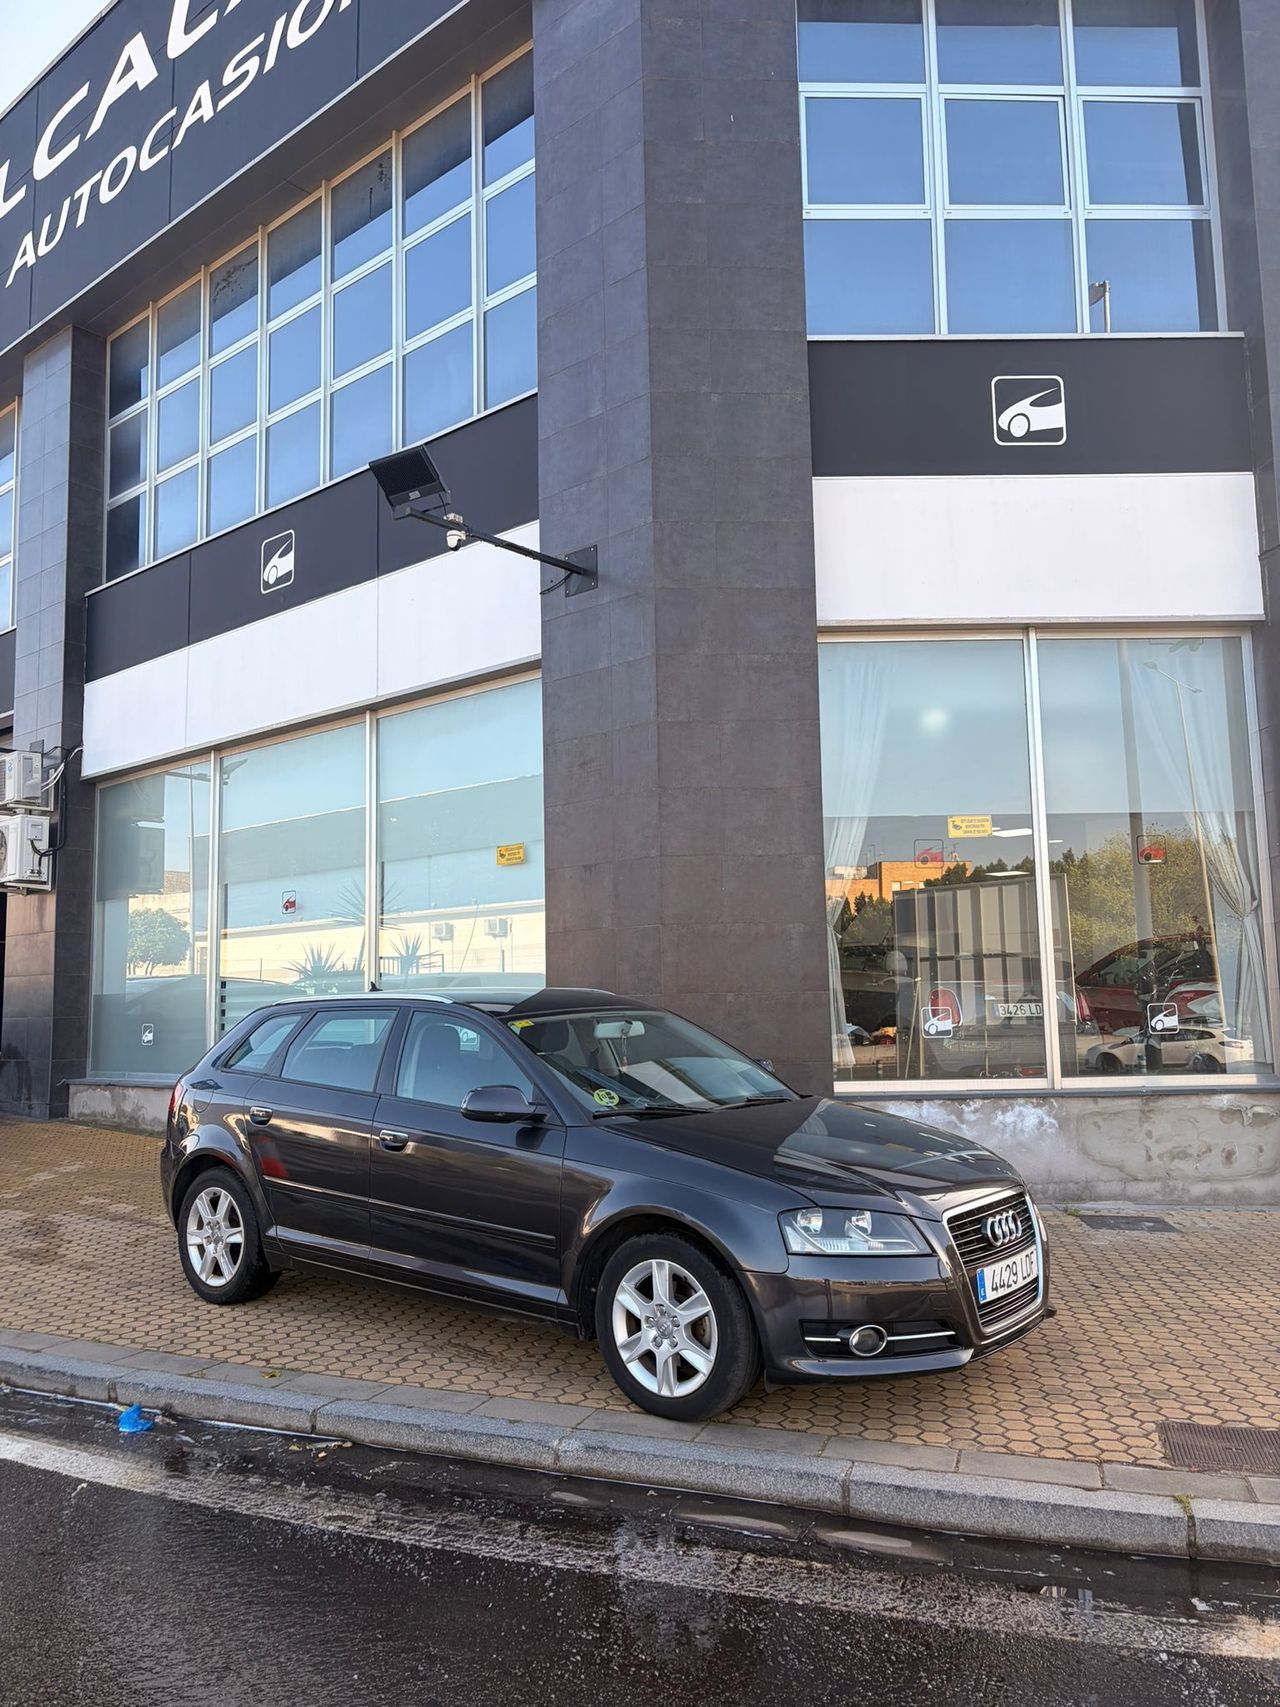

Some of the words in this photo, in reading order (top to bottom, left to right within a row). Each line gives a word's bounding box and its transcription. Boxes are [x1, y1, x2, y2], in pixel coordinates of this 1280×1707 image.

[0, 0, 242, 219] LCAL
[5, 0, 352, 288] AUTOCASIO
[999, 1005, 1027, 1016] 3426
[991, 1261, 1019, 1293] 4429
